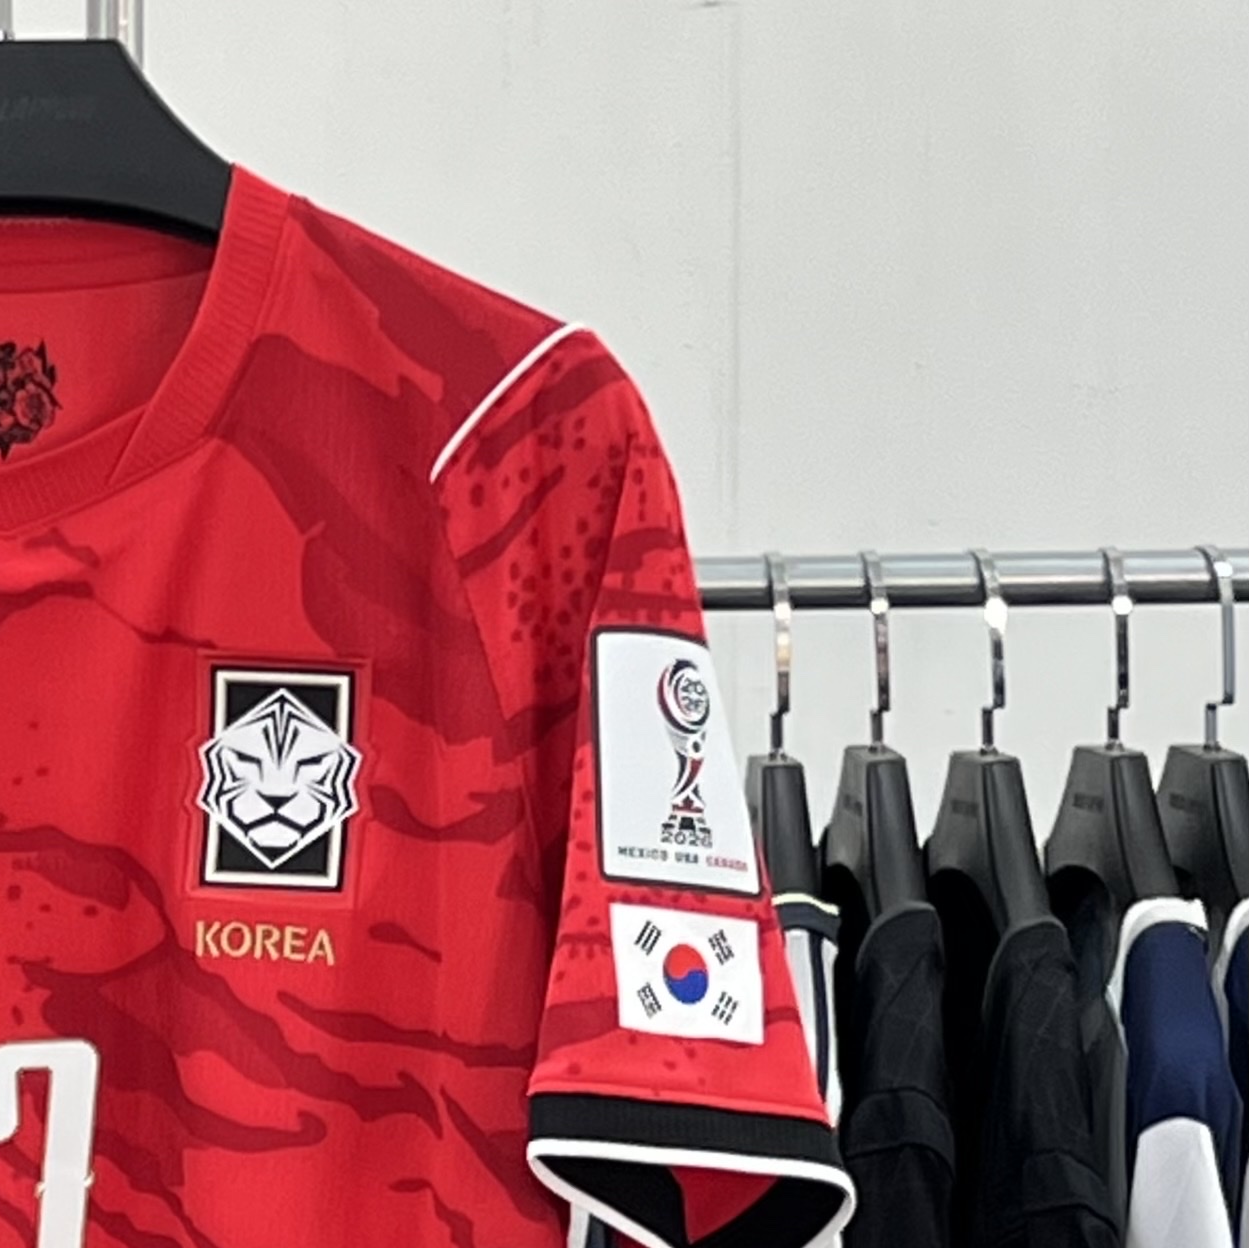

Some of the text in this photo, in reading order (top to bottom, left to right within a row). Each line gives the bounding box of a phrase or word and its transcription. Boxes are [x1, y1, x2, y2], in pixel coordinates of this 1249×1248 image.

[660, 830, 713, 849] 2026
[617, 846, 749, 873] MEXICO USA CANADA
[195, 920, 336, 966] KOREA
